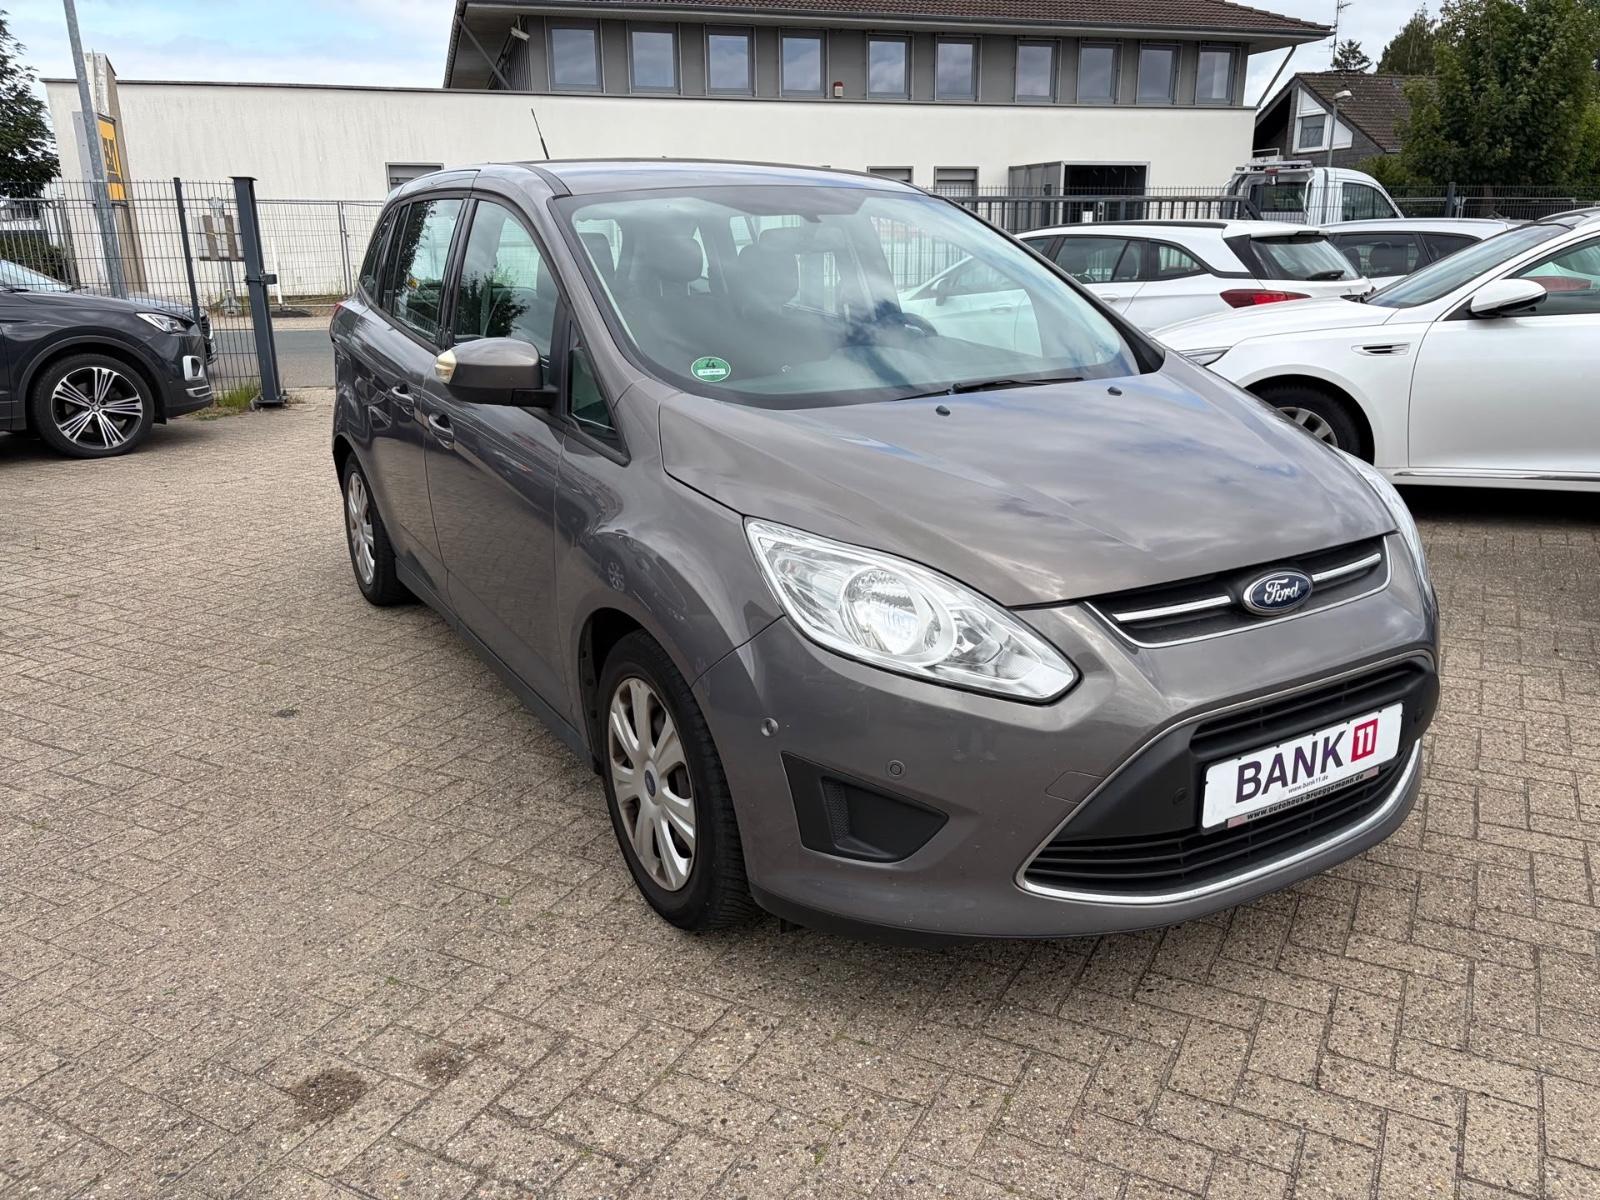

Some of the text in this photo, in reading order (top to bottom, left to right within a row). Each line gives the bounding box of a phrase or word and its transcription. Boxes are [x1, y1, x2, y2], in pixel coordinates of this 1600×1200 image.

[705, 358, 717, 369] 4
[1264, 578, 1300, 604] Ford
[1235, 729, 1347, 804] BANK
[1247, 773, 1364, 820] www.autohaus-brueggemann.de
[1288, 775, 1329, 794] www.bank11.de
